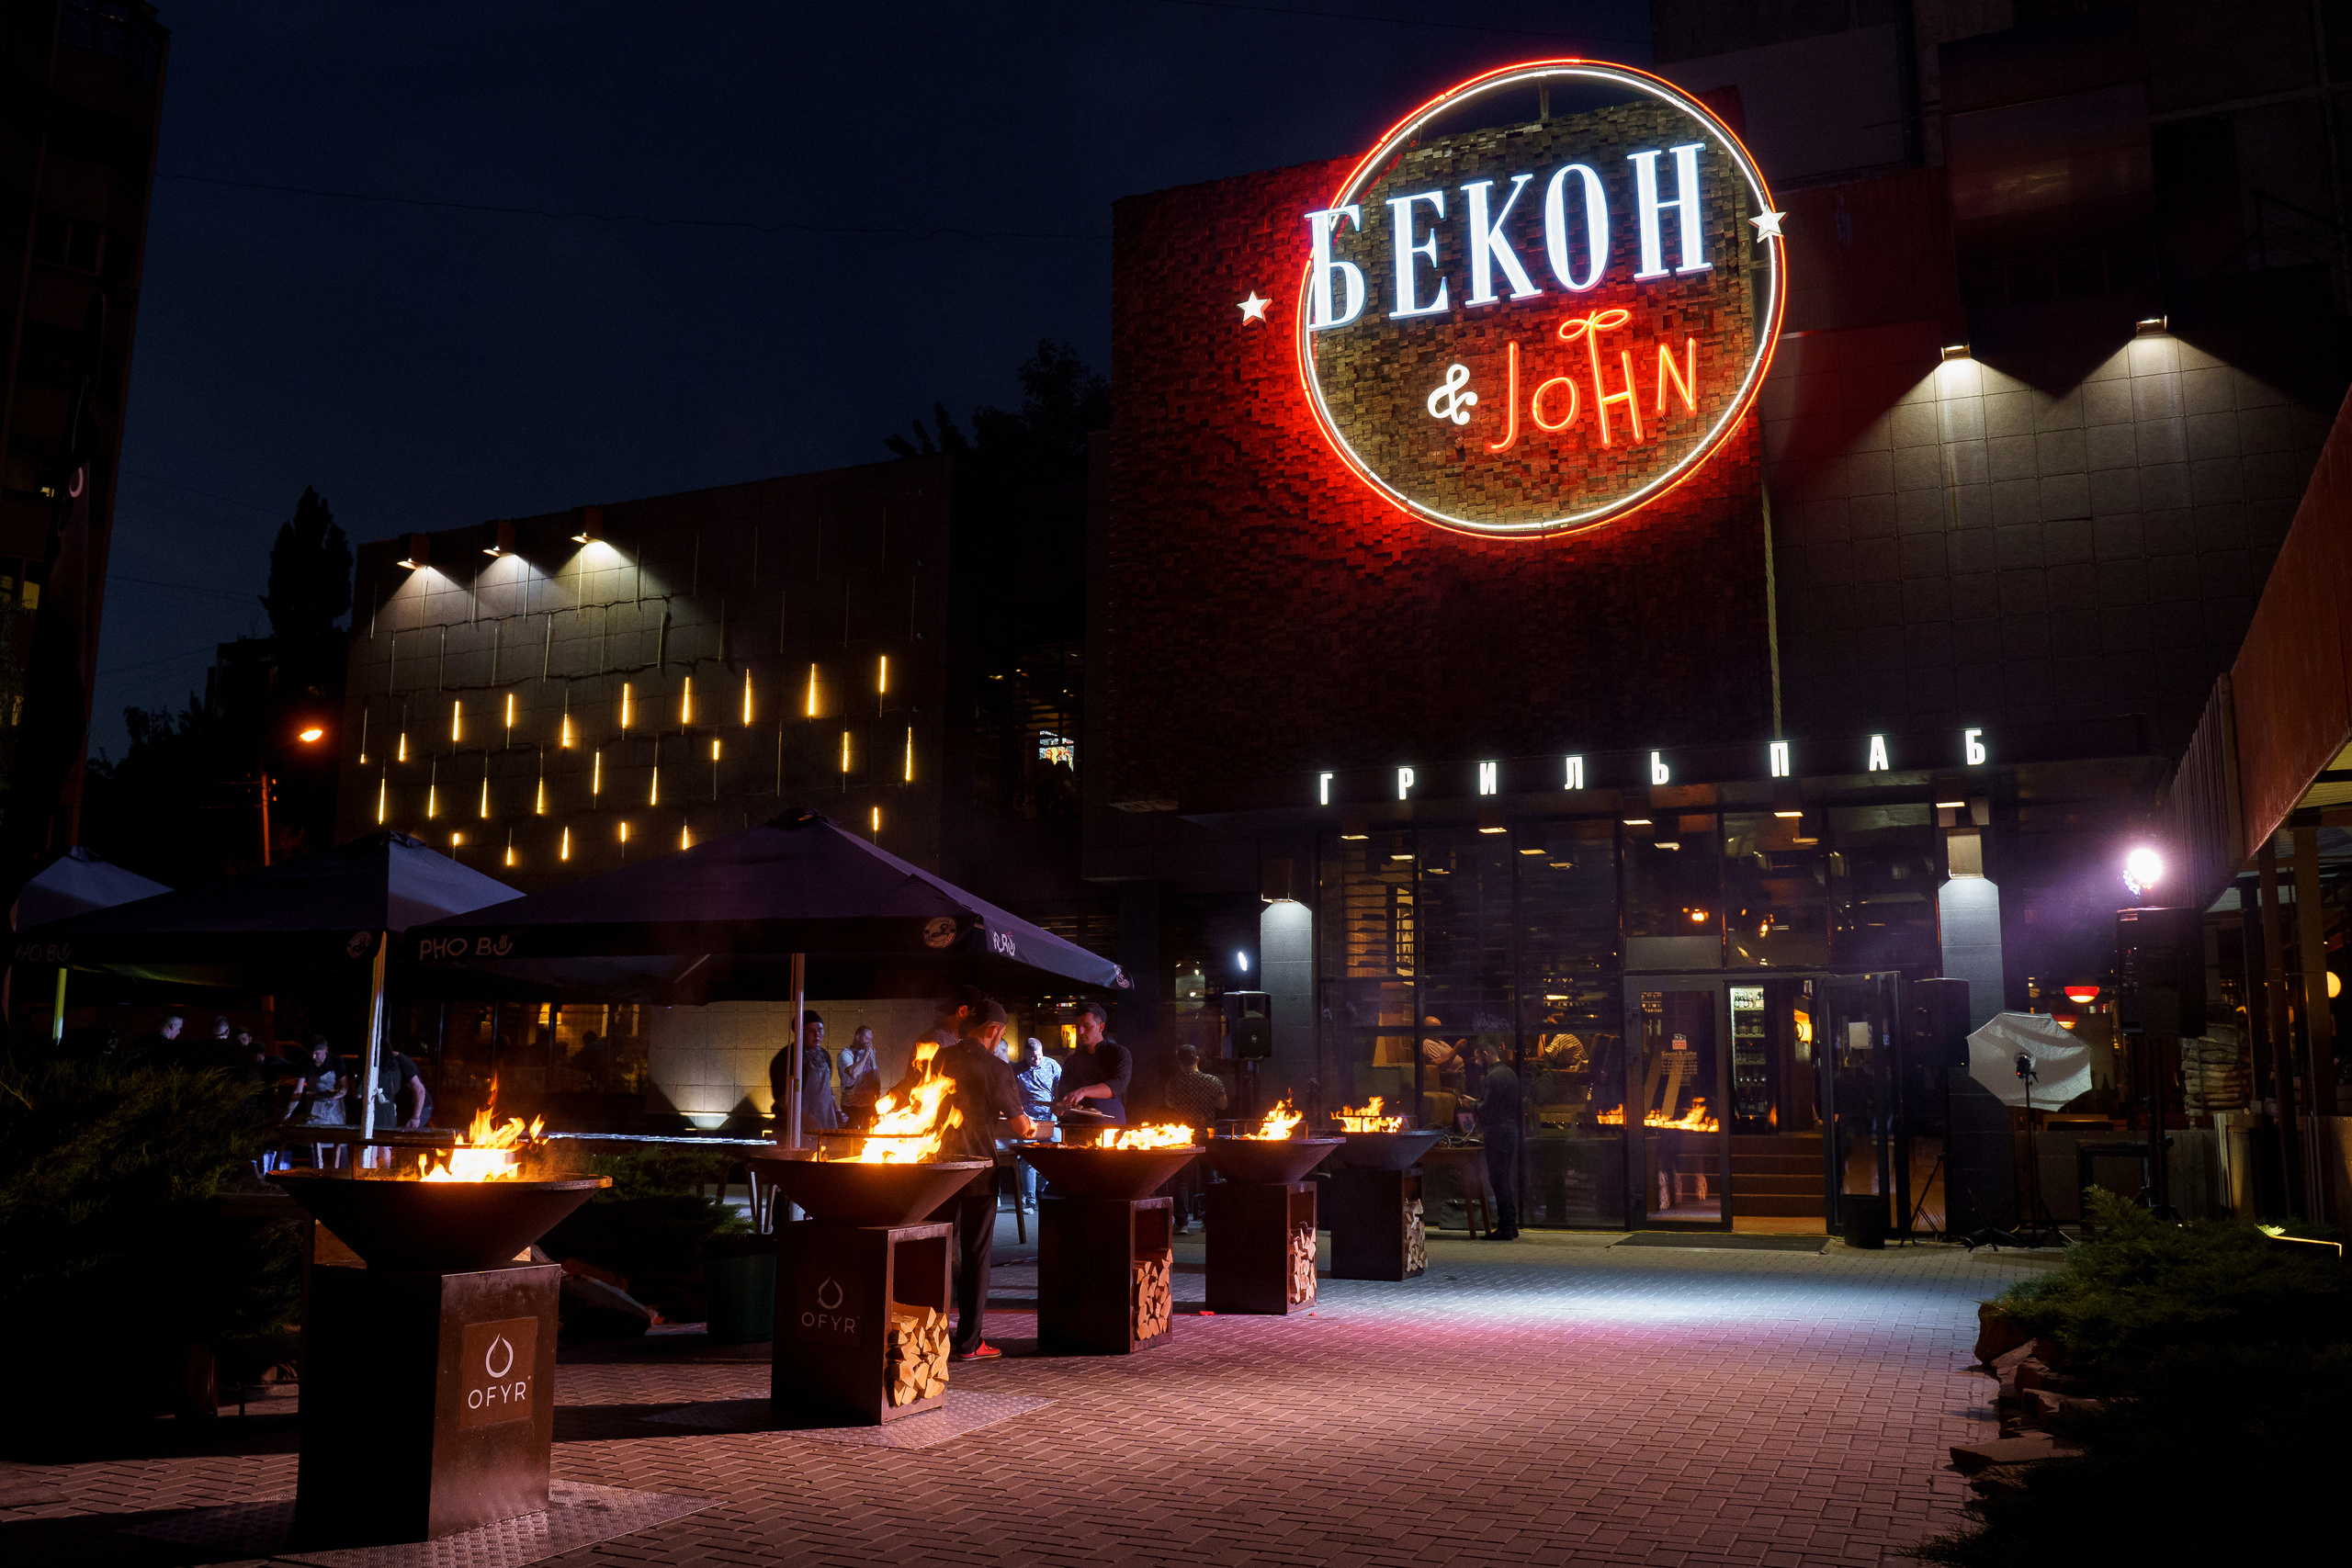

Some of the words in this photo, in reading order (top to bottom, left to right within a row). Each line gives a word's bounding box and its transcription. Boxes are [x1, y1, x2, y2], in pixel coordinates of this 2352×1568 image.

[1304, 143, 1713, 332] БЕКОН
[1427, 364, 1477, 425] &
[1319, 750, 1669, 806] ГРИЛЬ
[1770, 728, 1985, 777] ПАБ
[15, 943, 43, 962] HO
[419, 937, 469, 961] PHO
[801, 1312, 855, 1334] OFYR
[468, 1381, 526, 1409] OFYR
